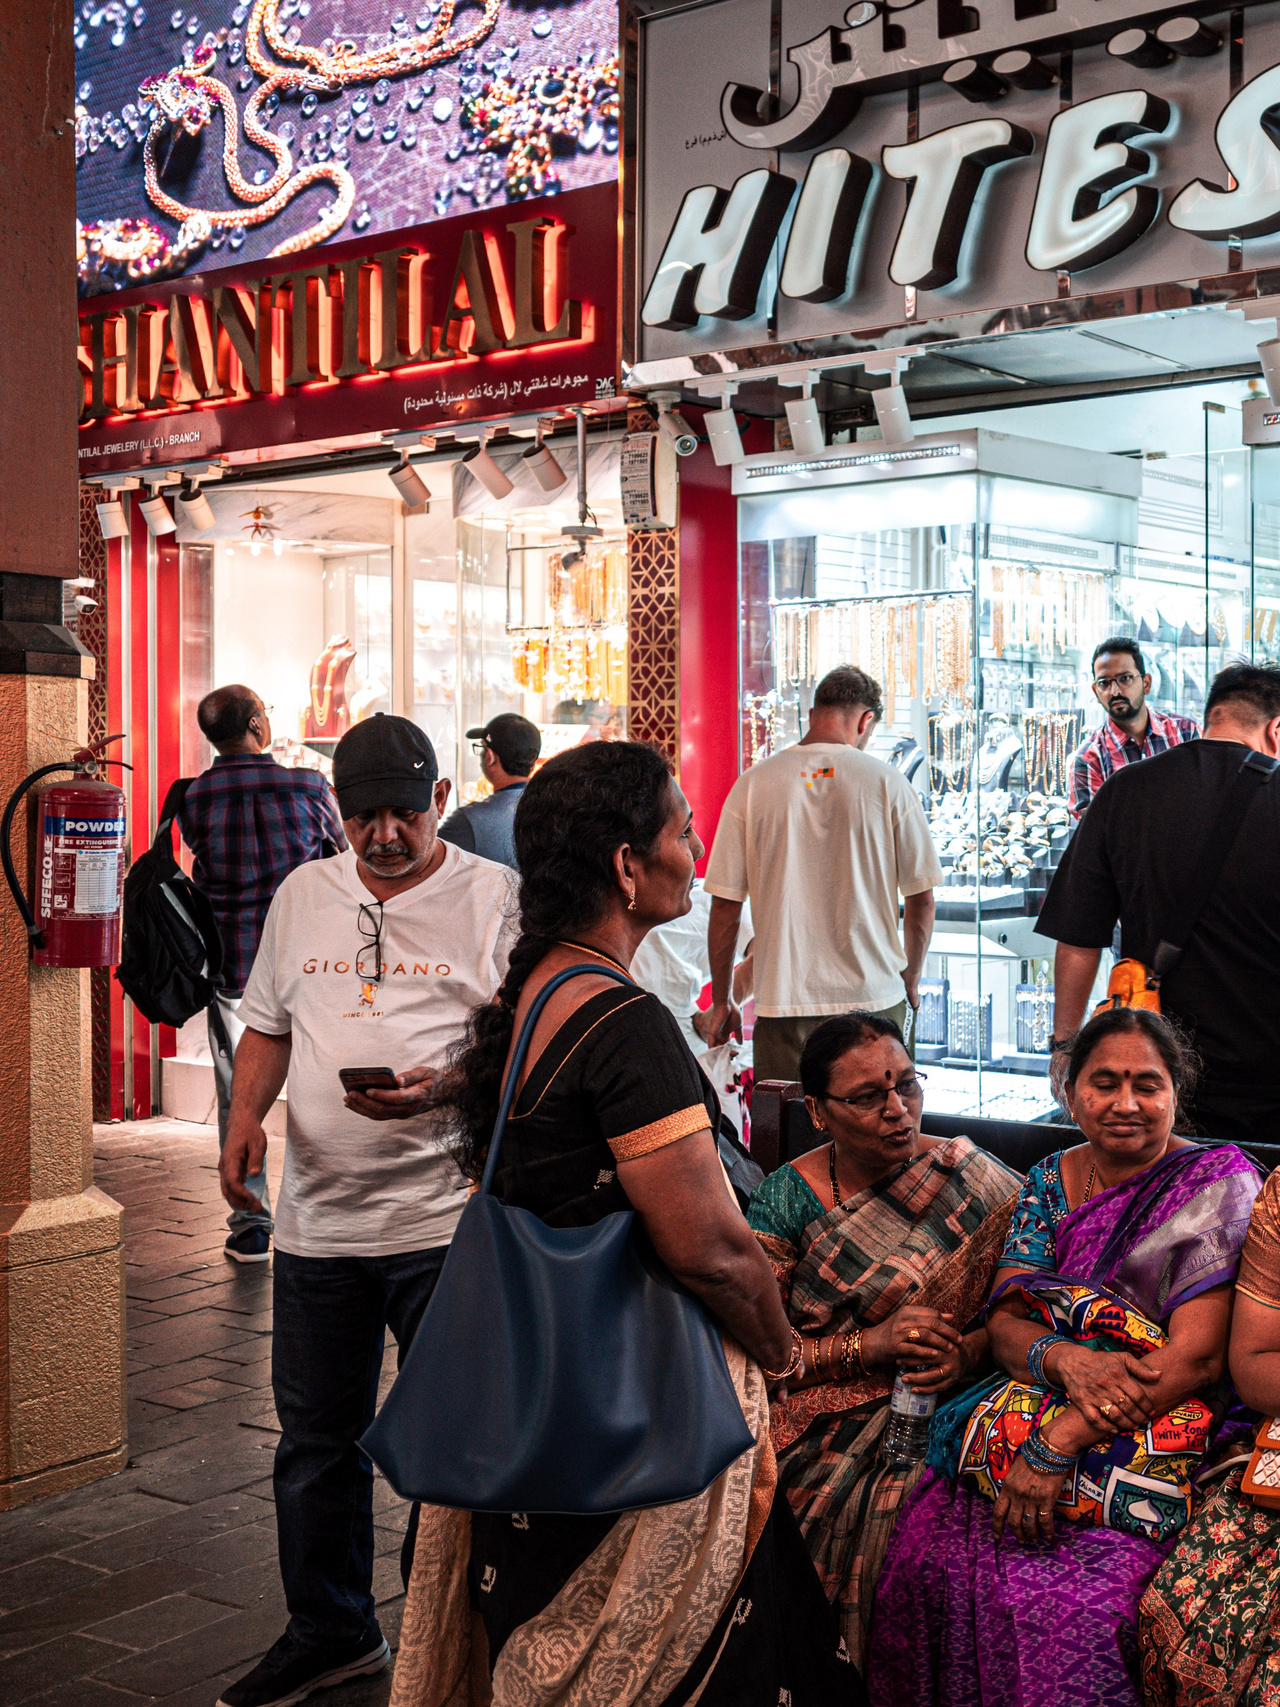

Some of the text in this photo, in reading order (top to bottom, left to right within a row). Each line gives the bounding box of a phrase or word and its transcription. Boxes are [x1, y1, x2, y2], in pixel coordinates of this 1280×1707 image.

[78, 217, 584, 426] HANTILAL
[550, 374, 589, 388] مجوهرات
[467, 384, 482, 399] ذات
[102, 440, 139, 456] JEWELERY
[139, 436, 164, 452] (L.L.C.)
[169, 430, 200, 446] BRANCH
[65, 820, 125, 832] POWDER
[302, 958, 451, 977] GIORDANO
[1181, 1423, 1208, 1440] long
